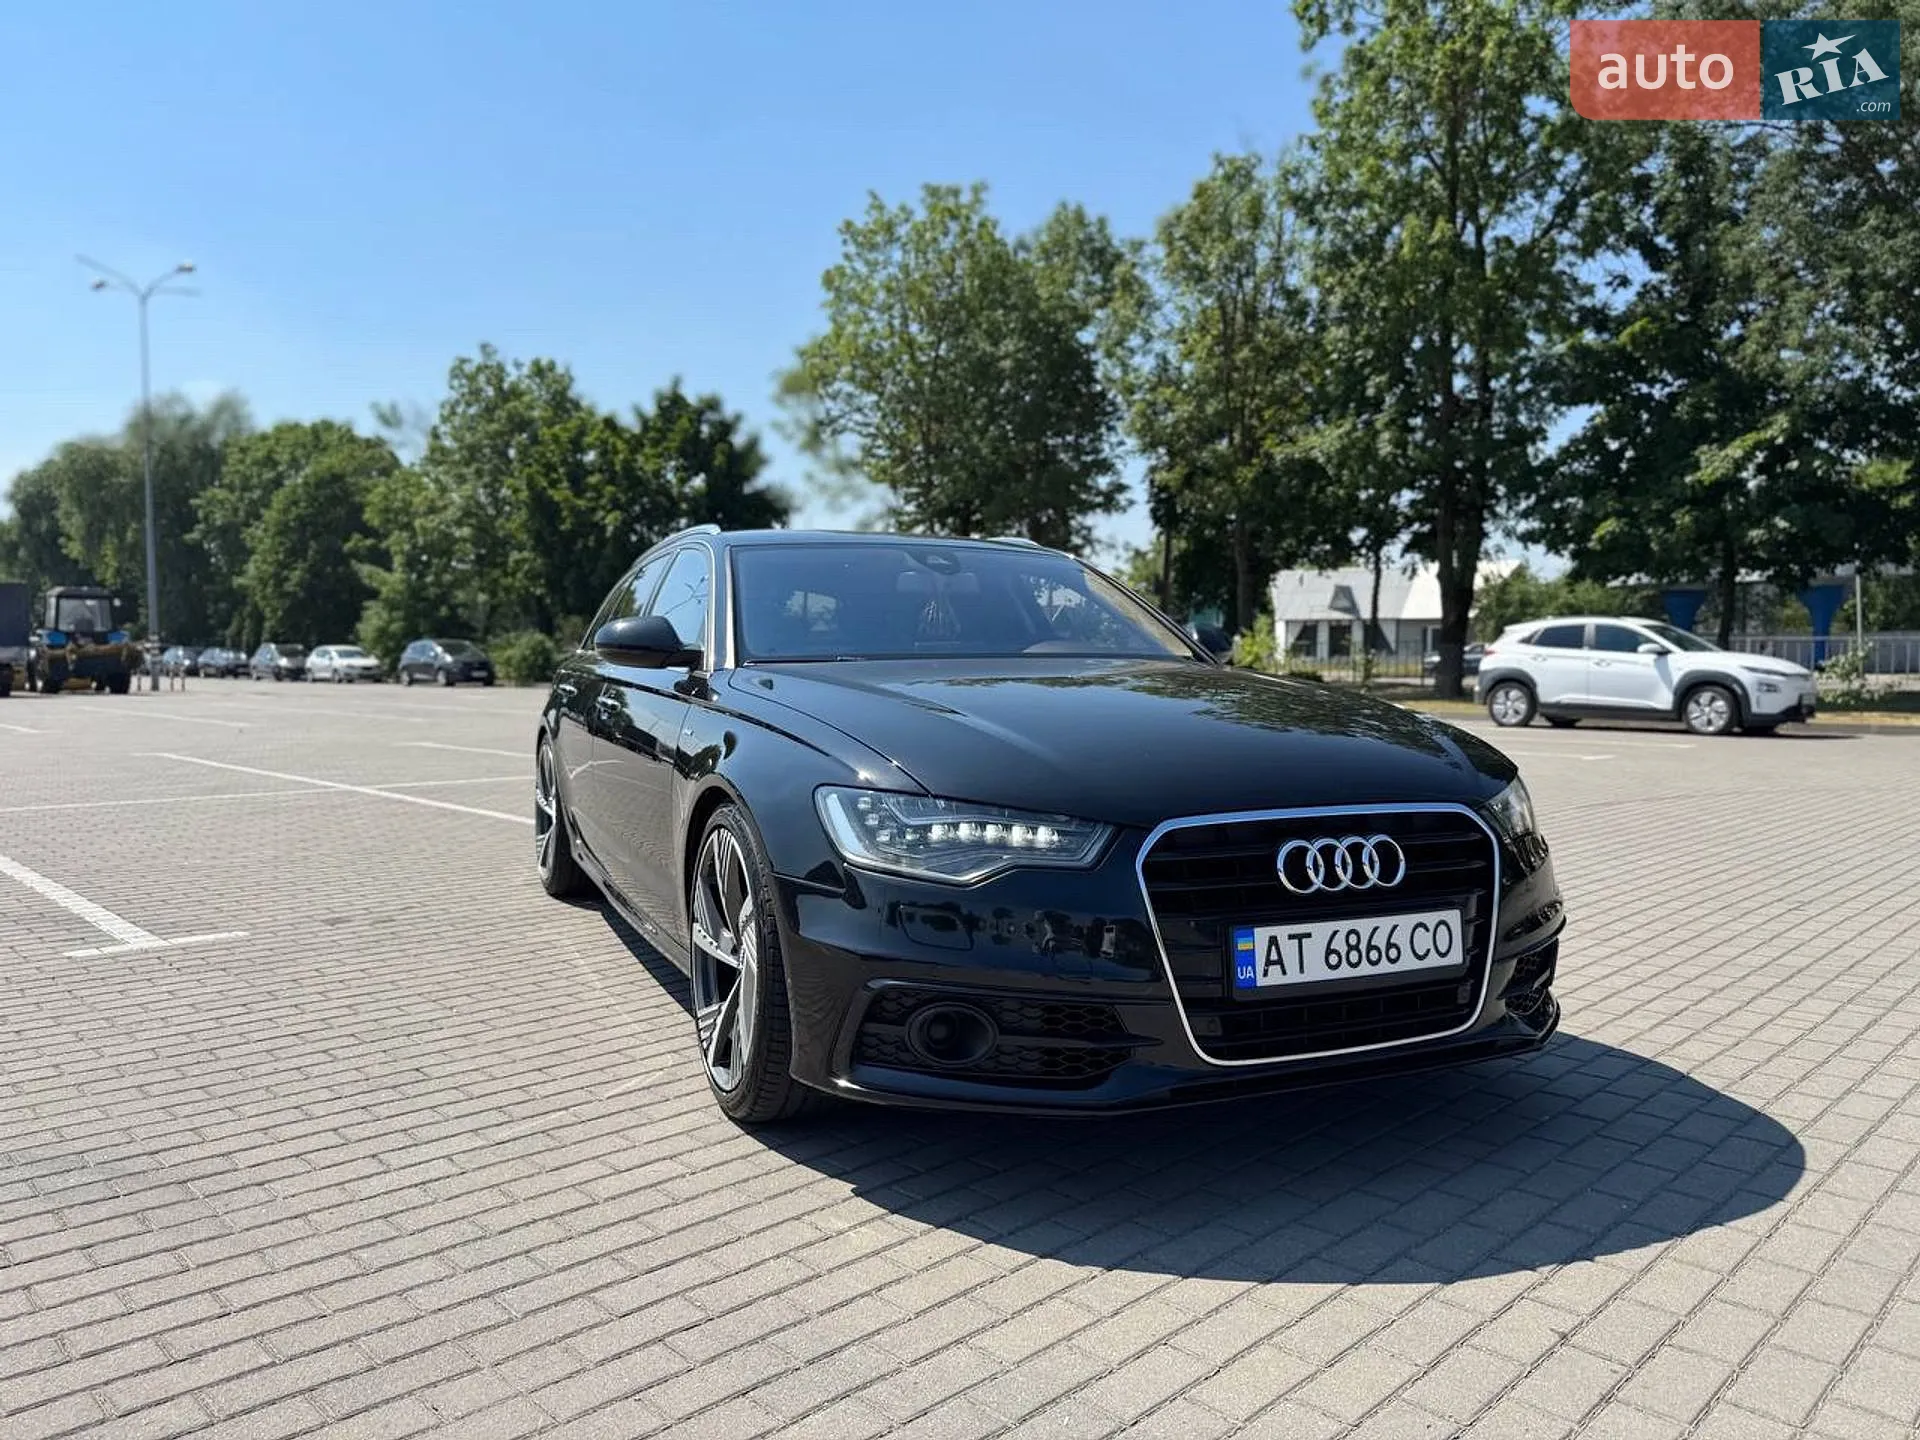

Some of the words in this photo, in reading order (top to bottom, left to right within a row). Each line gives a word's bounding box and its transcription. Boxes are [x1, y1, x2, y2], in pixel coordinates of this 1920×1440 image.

[1262, 932, 1312, 978] AT
[1324, 924, 1401, 971] 6866
[1409, 919, 1453, 961] CO
[1237, 966, 1254, 980] UA
